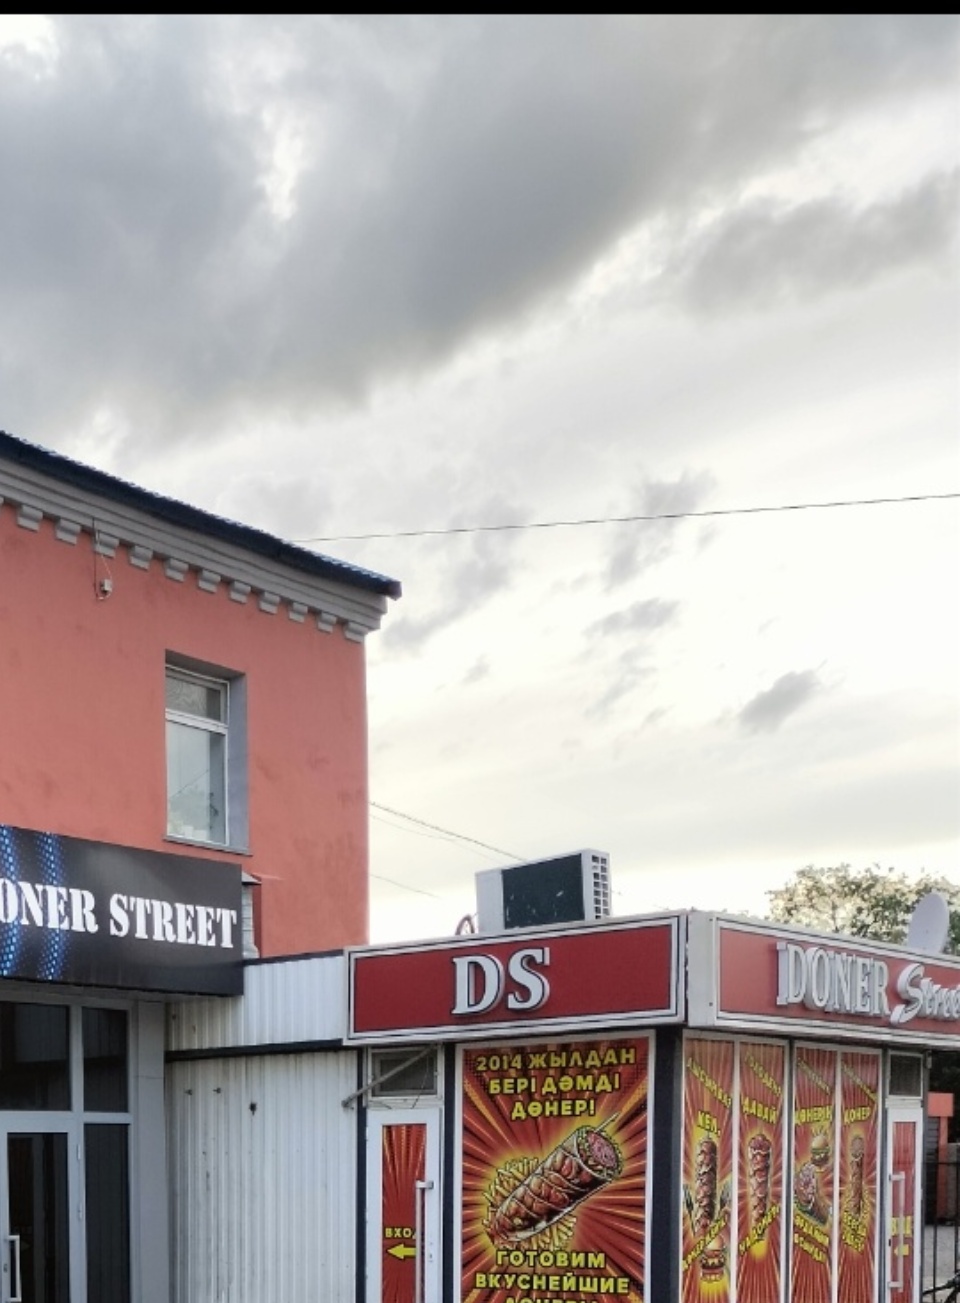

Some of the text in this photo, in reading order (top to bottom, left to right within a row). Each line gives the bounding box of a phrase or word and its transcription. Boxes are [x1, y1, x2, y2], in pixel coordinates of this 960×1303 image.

[109, 893, 238, 949] STREET
[451, 947, 550, 1015] DS
[776, 942, 891, 1015] DONER
[476, 1048, 636, 1071] 2014 ЖЫЛДАН
[489, 1073, 620, 1095] БЕРІ ДӘМДІ
[511, 1099, 595, 1120] ДӨНЕР!
[496, 1250, 605, 1268] ГОТОВИМ
[475, 1272, 629, 1293] ВКУСНЕЙШИЕ
